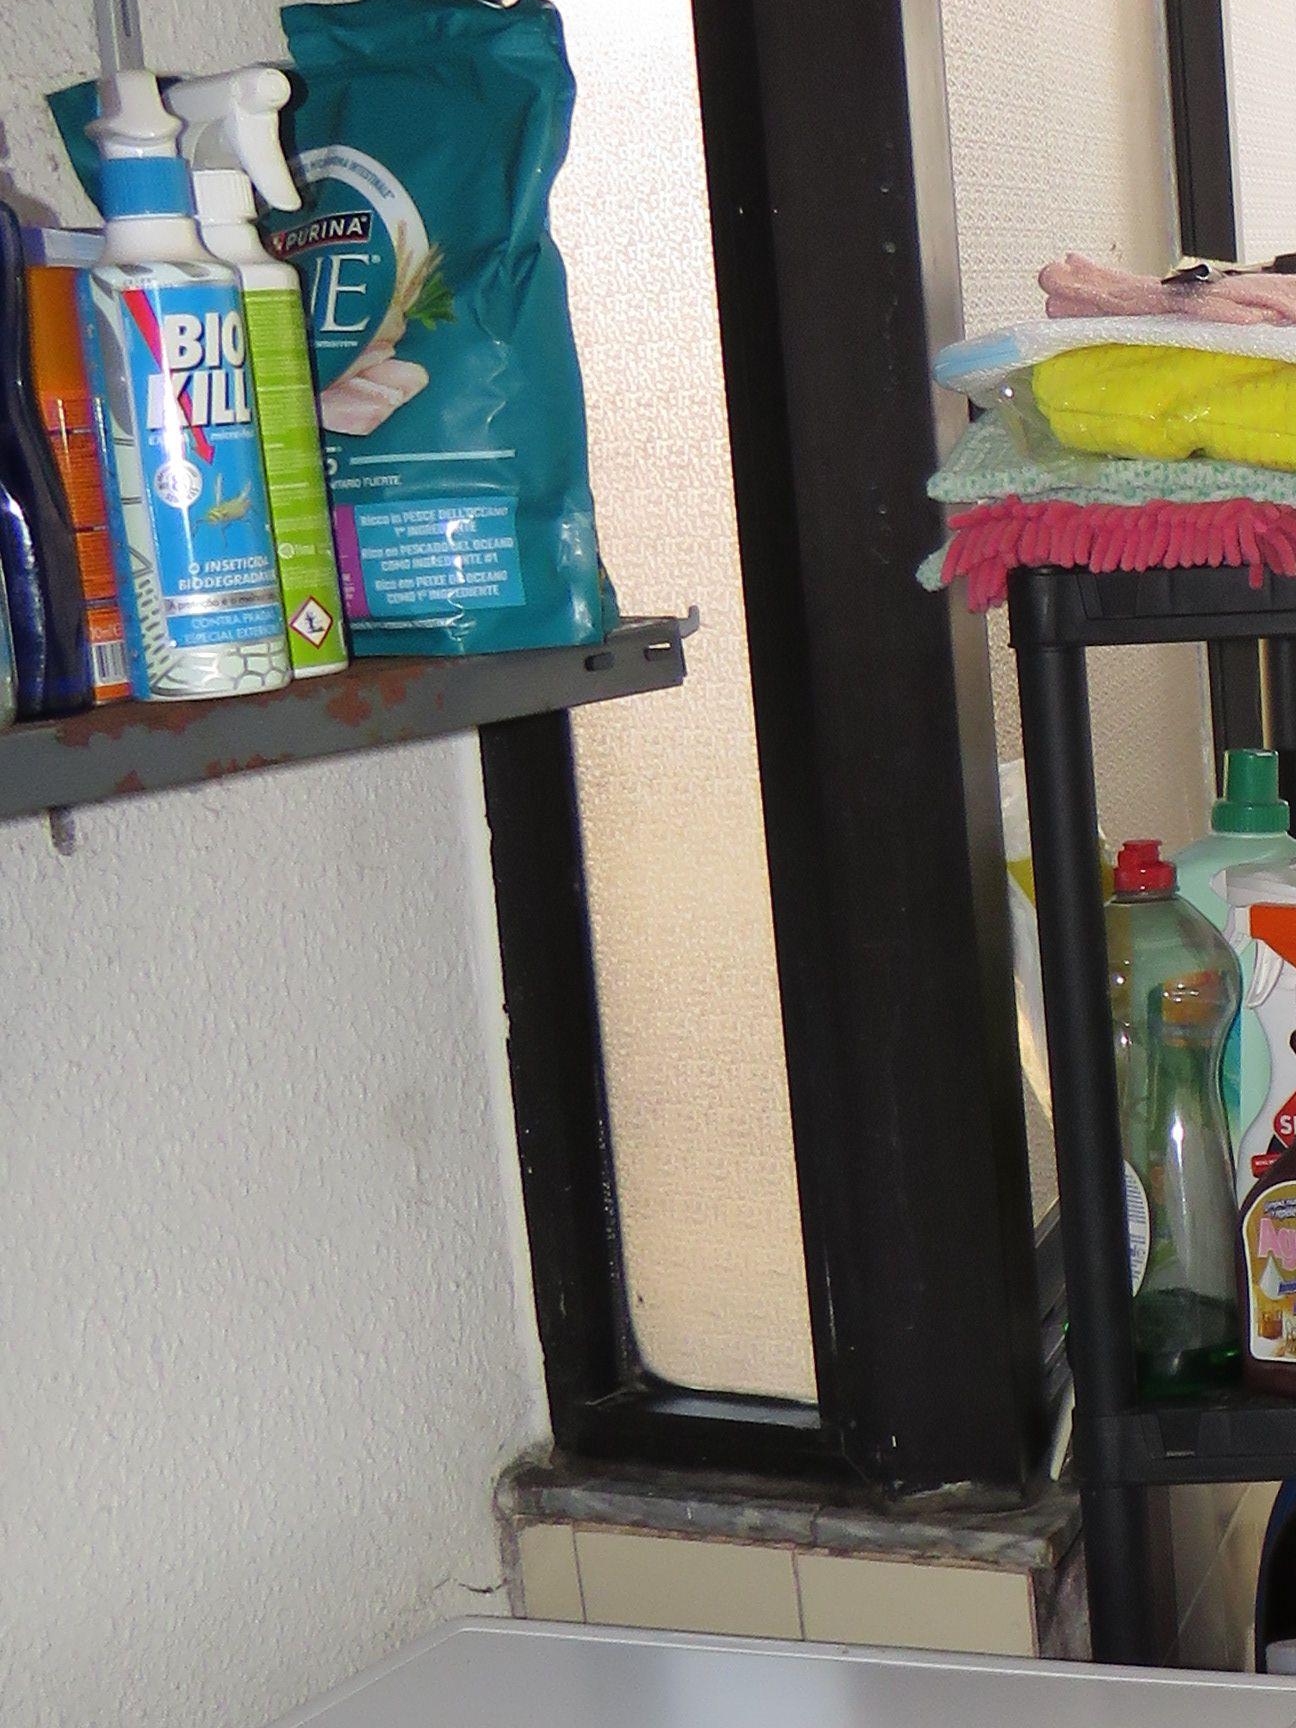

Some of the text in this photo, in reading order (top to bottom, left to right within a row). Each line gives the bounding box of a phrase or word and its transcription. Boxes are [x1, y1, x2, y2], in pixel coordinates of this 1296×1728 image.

[285, 217, 364, 250] PURINA
[163, 310, 246, 370] BIO
[147, 368, 251, 430] KILL
